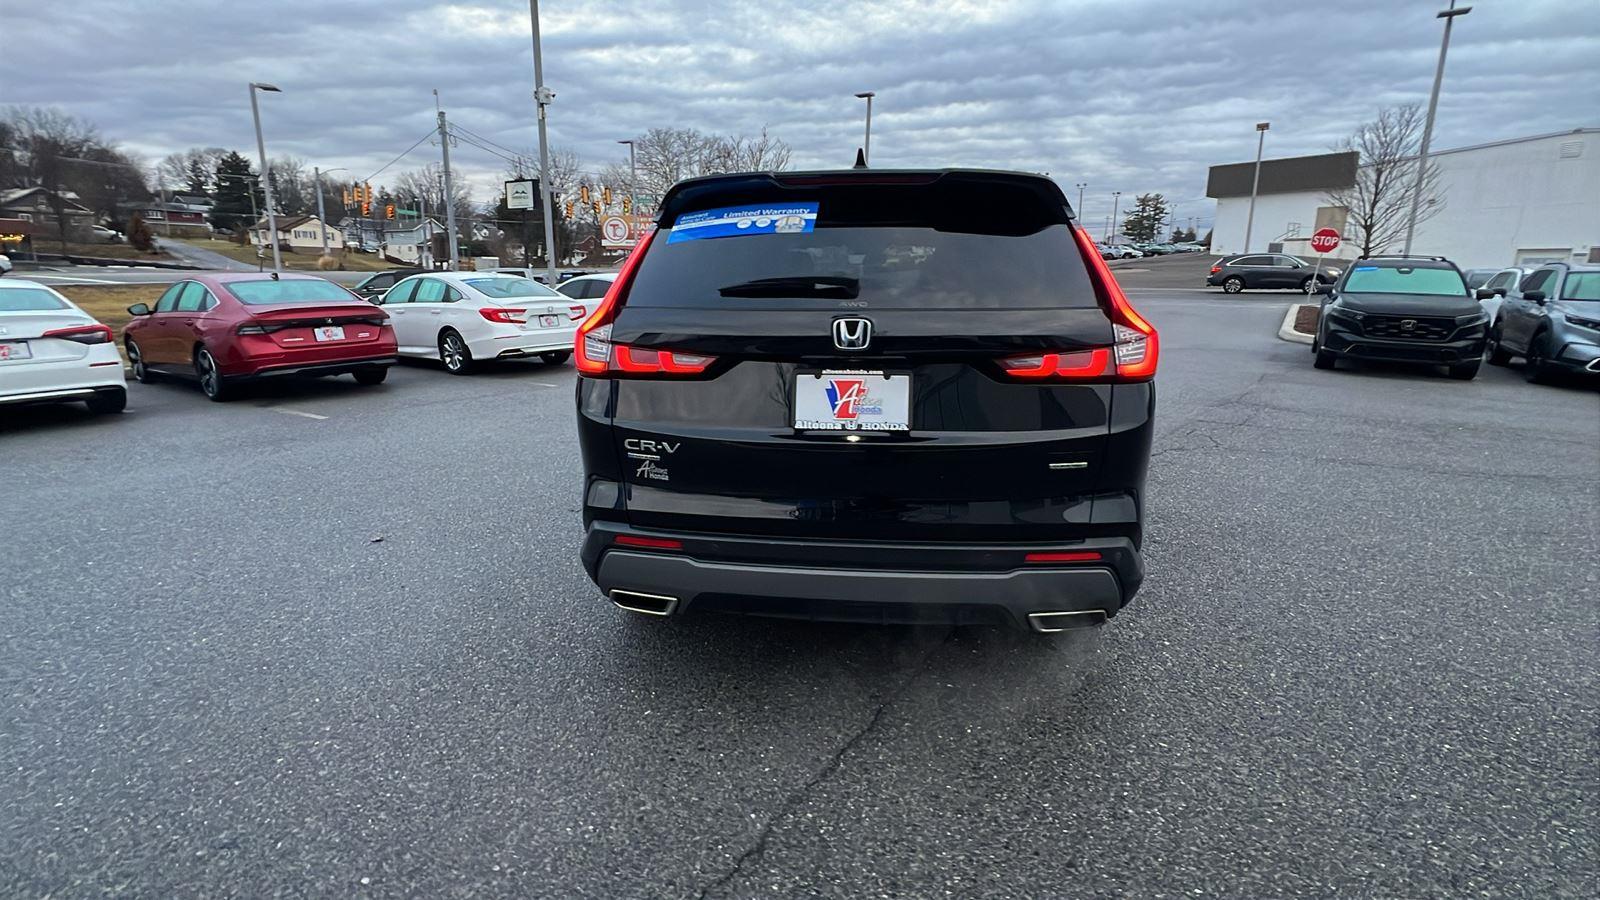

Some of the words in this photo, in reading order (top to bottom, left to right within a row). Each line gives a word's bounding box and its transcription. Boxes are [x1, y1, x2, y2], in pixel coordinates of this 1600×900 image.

[723, 209, 761, 219] Limited
[762, 207, 811, 216] Warranty
[1312, 235, 1339, 247] STOP
[794, 420, 842, 430] Altoona
[861, 421, 910, 431] HONDA
[624, 438, 681, 454] CR-V
